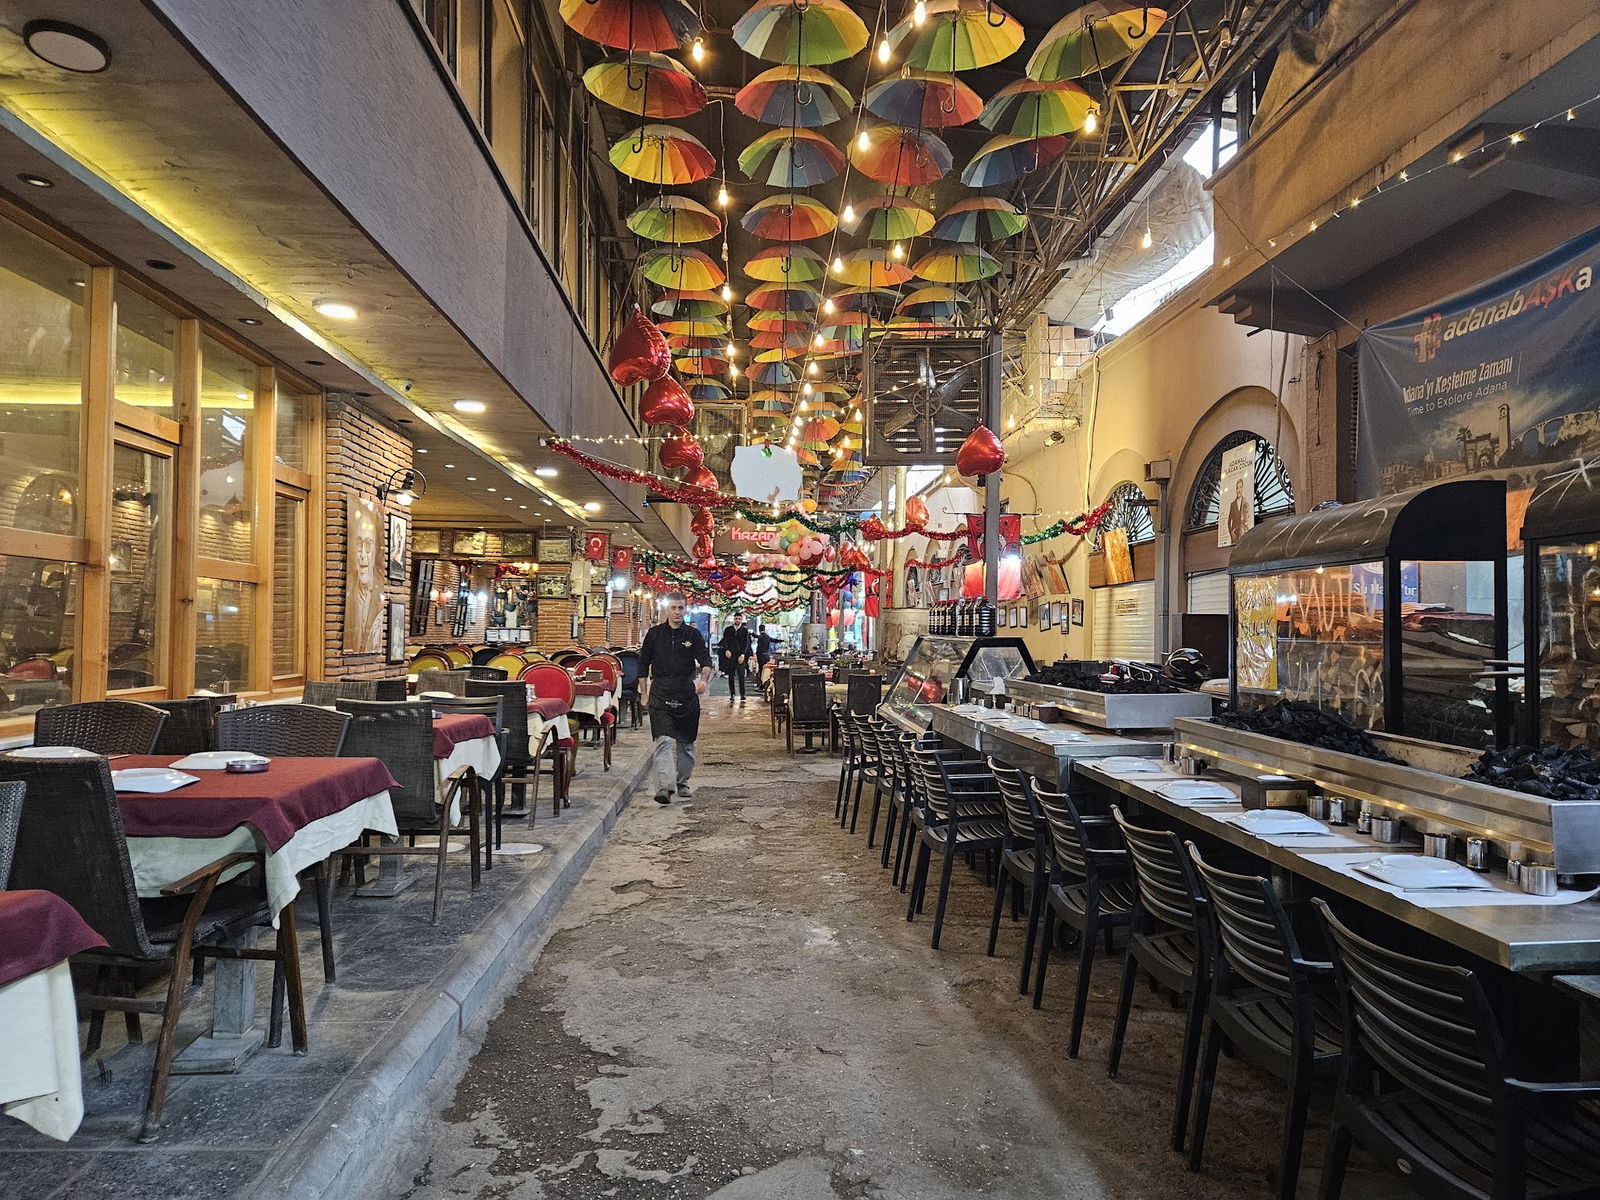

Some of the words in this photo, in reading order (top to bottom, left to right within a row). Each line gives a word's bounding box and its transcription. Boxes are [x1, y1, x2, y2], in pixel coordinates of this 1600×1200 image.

[1435, 368, 1477, 394] Keşfetme
[1478, 356, 1513, 382] Zamanı
[1426, 402, 1435, 412] to
[1437, 391, 1473, 408] Explore
[1475, 381, 1508, 398] Adana
